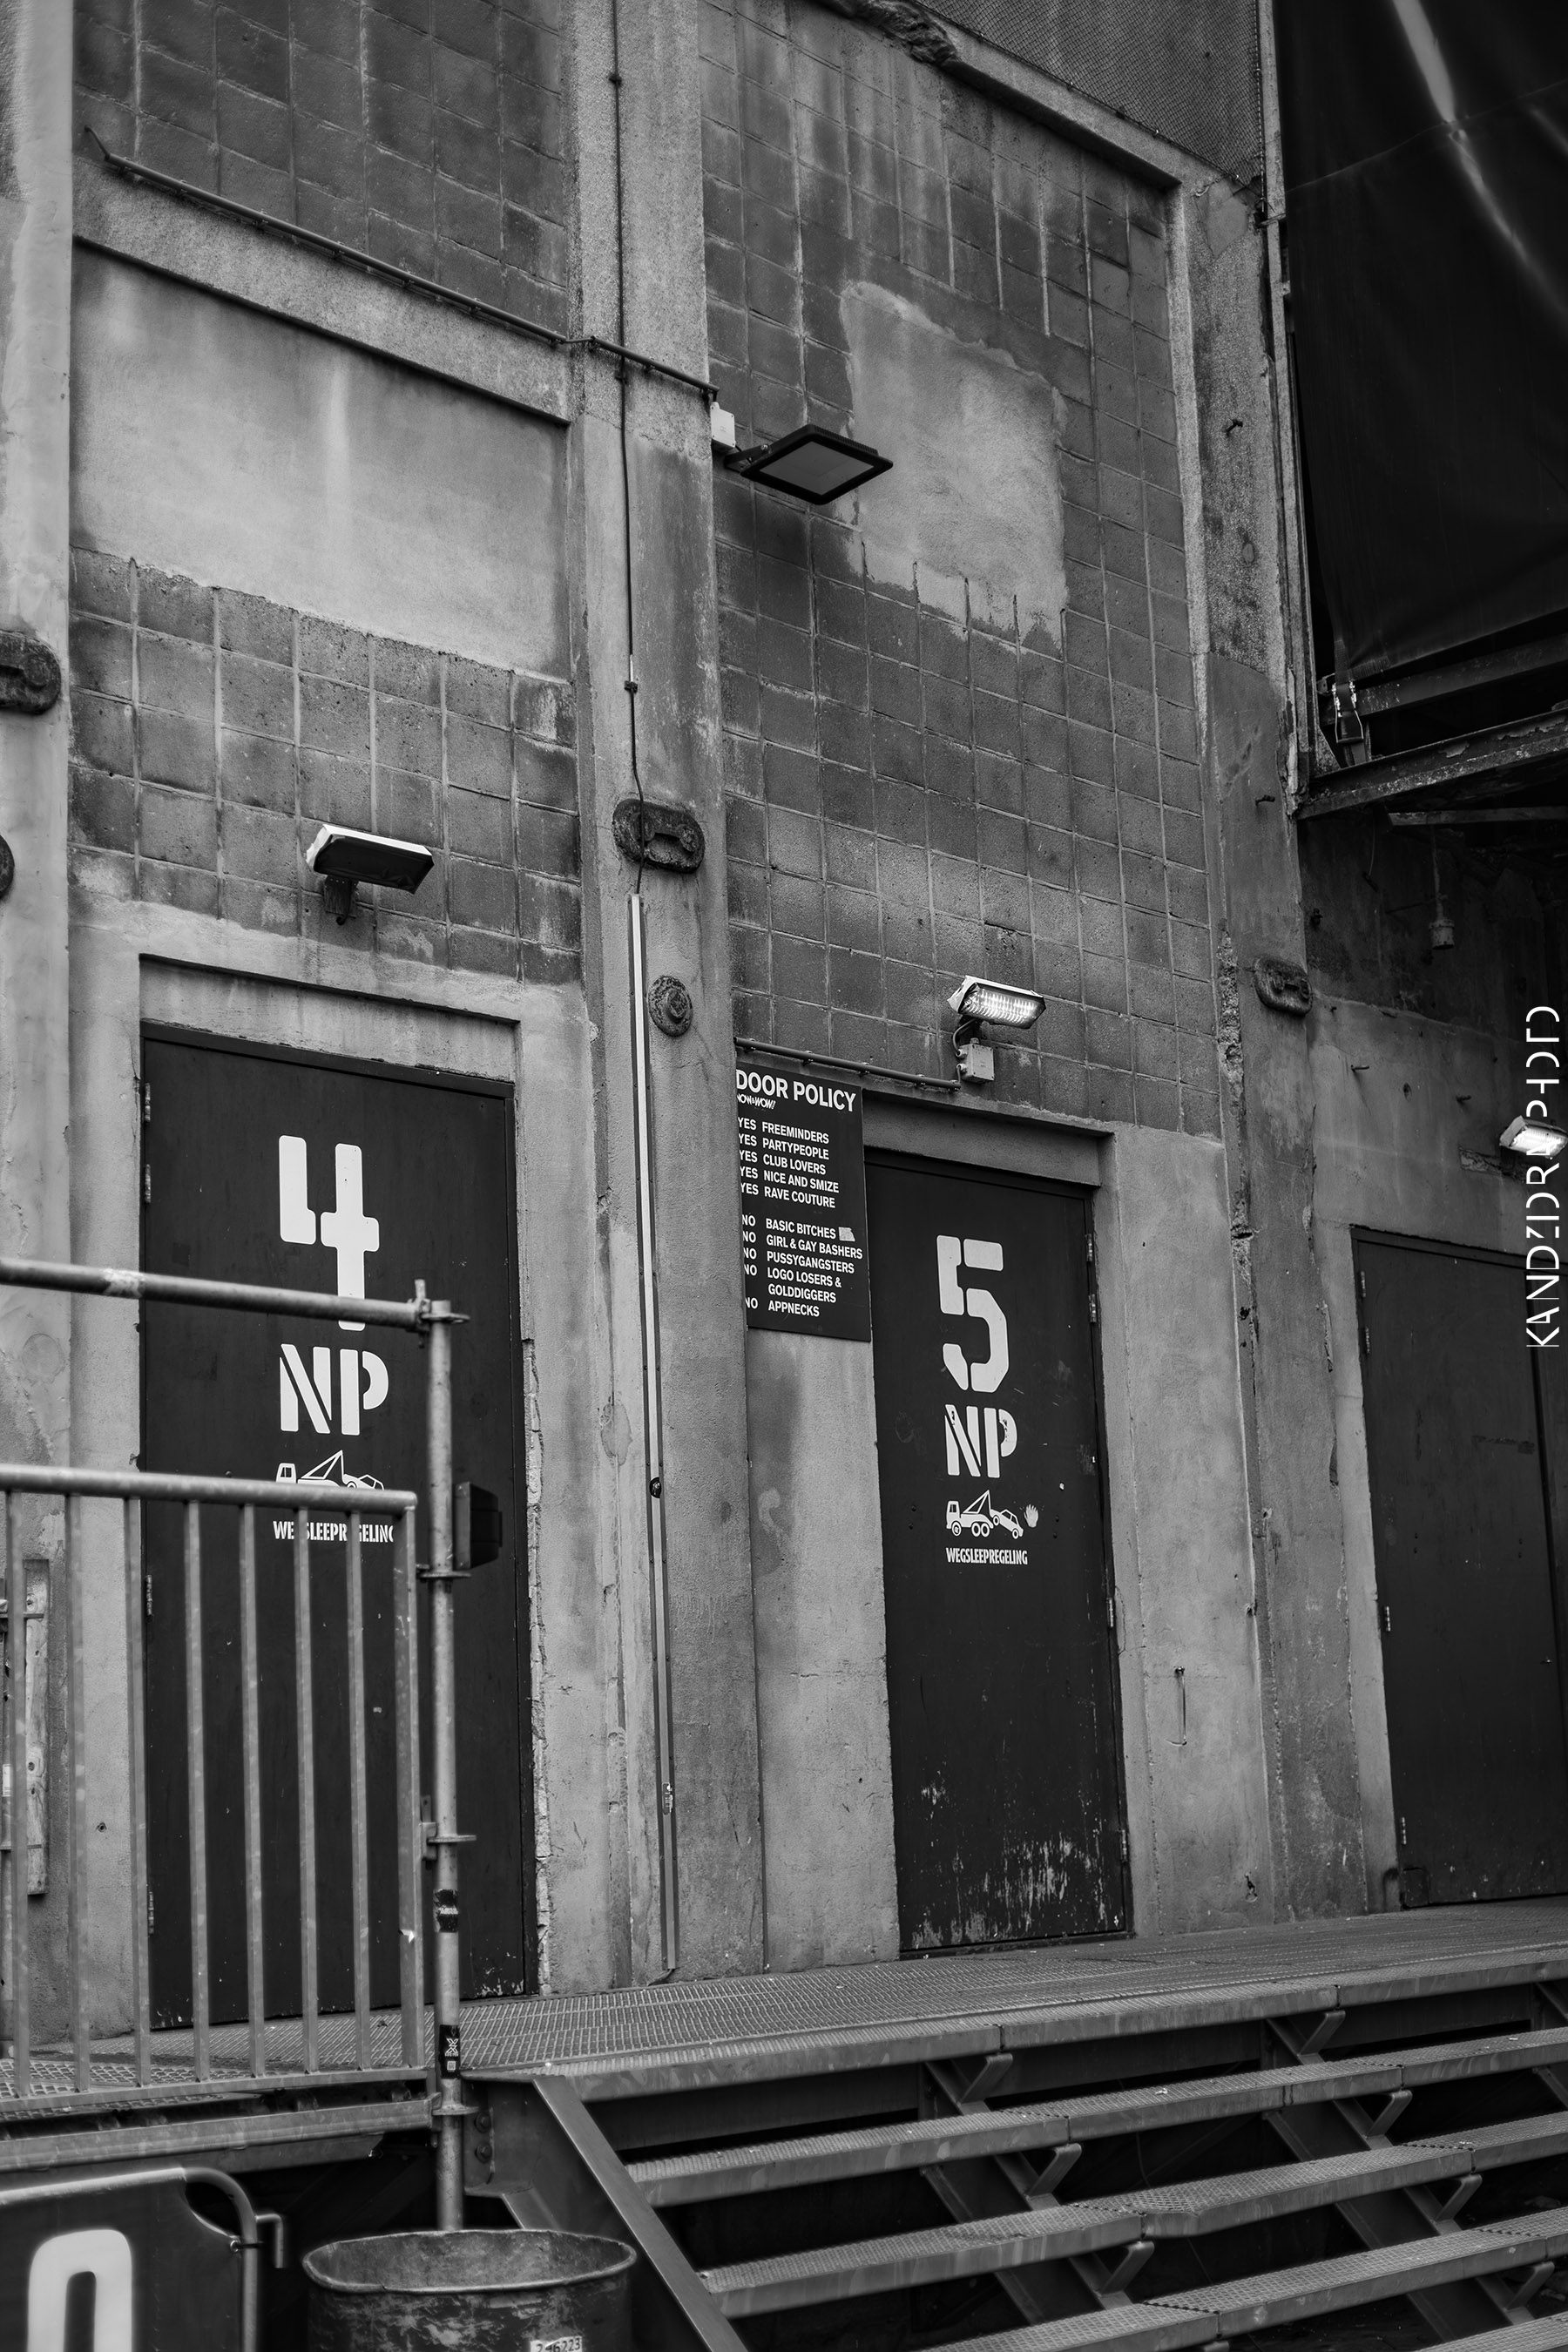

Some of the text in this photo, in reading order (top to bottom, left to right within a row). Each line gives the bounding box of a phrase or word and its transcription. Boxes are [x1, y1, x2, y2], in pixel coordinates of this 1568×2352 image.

[736, 1070, 856, 1112] DOOR POLICY
[738, 1117, 829, 1144] YES FREEMINDERS
[739, 1133, 829, 1160] YES PARTYPEOPLE
[740, 1150, 826, 1175] YES CLUB LOVERS
[740, 1166, 839, 1193] YES NICE AND SMIZE
[741, 1183, 835, 1208] YES RAVE COUTURE
[279, 1134, 380, 1331] 4
[742, 1214, 836, 1239] NO BASIC BITCHES
[743, 1231, 862, 1259] NO GIRL & GAY BASHERS
[744, 1247, 855, 1274] NO PUSSYGANGSTERS
[744, 1264, 841, 1288] NO LOGO LOSERS &
[746, 1297, 820, 1317] NO APPNECKS
[768, 1284, 836, 1303] GOLDDIGGERS
[936, 1234, 1009, 1394] 5
[280, 1343, 389, 1436] NP
[944, 1403, 1018, 1479] NP
[945, 1546, 1028, 1565] WEGSLEEPREGELING
